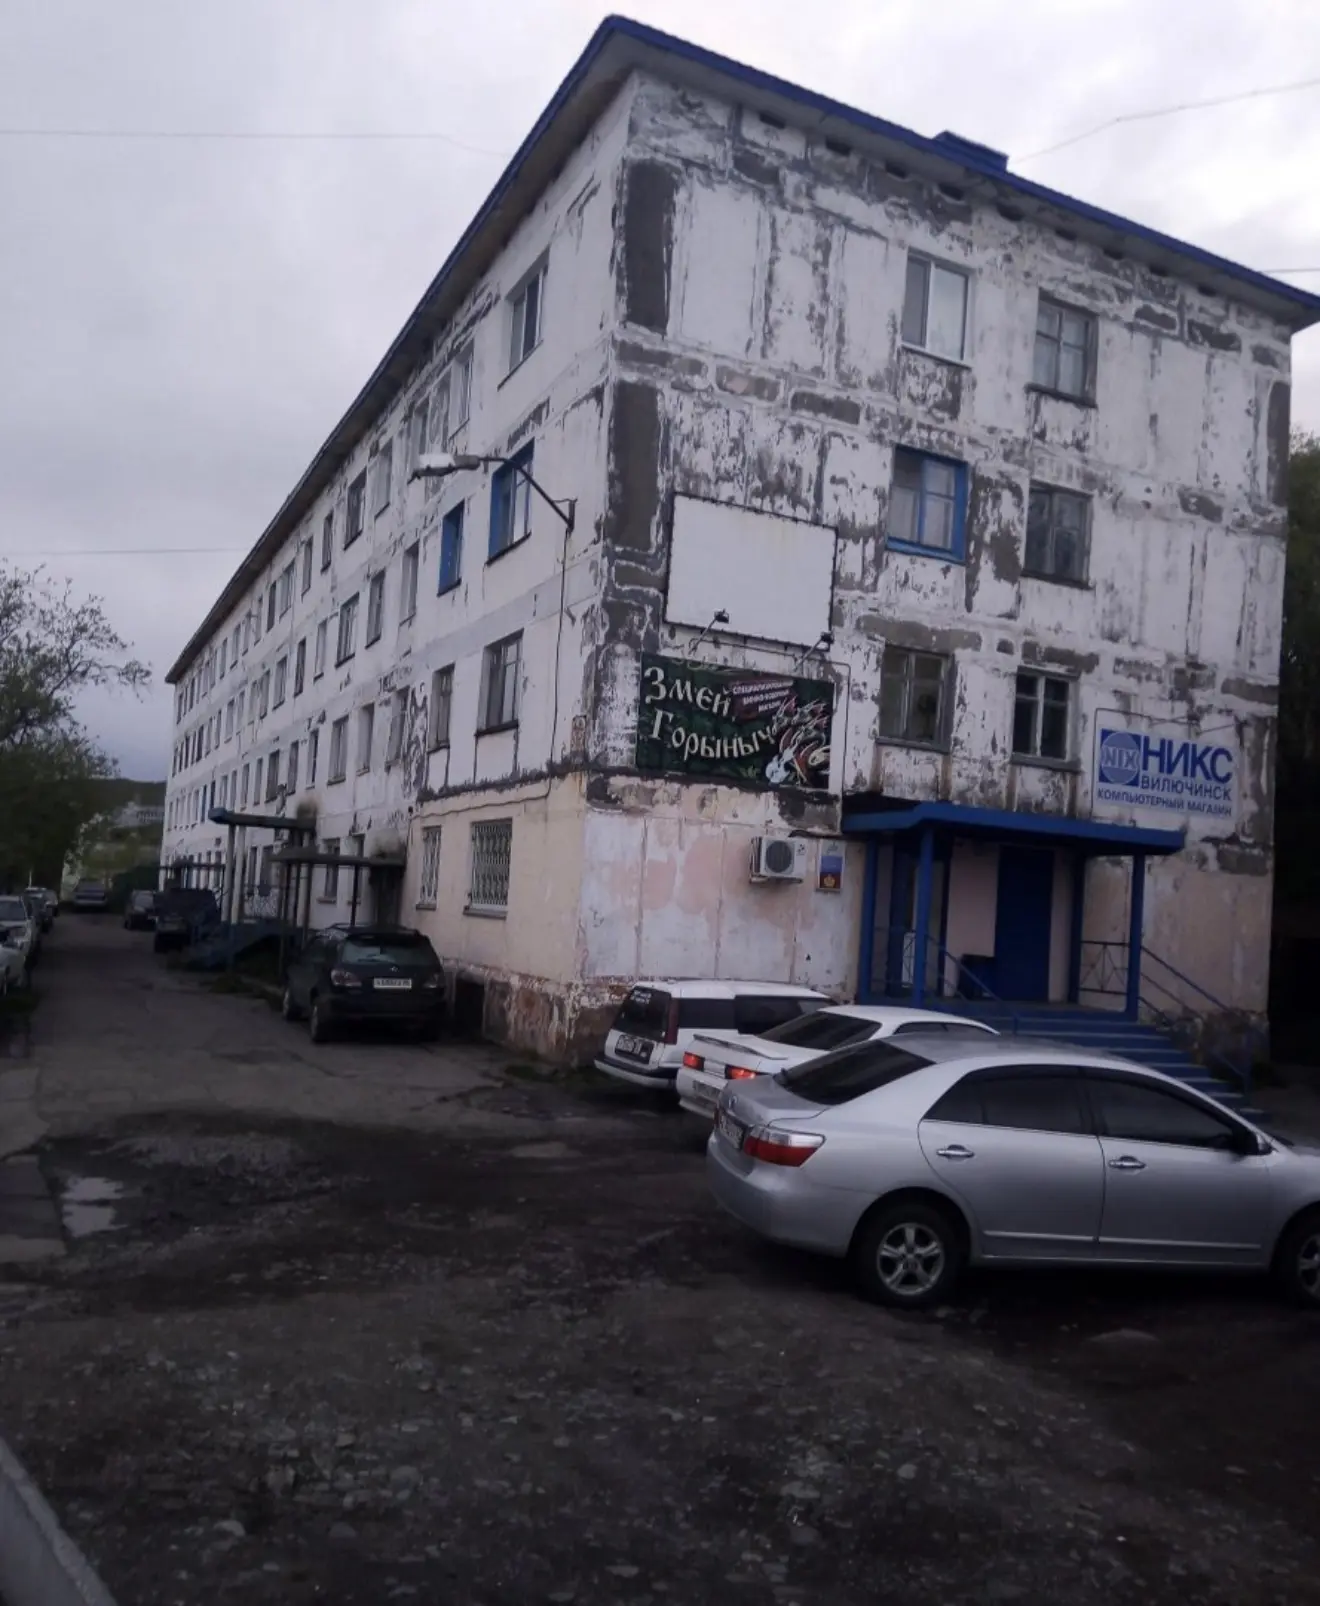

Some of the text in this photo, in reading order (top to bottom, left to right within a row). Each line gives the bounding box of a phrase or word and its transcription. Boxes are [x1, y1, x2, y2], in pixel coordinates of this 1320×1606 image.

[644, 666, 731, 717] Змей
[650, 708, 775, 761] Горыныч
[1103, 746, 1138, 770] NIX
[1142, 736, 1233, 784] НИКС
[1097, 788, 1232, 817] КОМПЬЮТЕРНЫЙ МАГАЗИН
[1141, 776, 1232, 801] ВИЛЮЧИНСК
